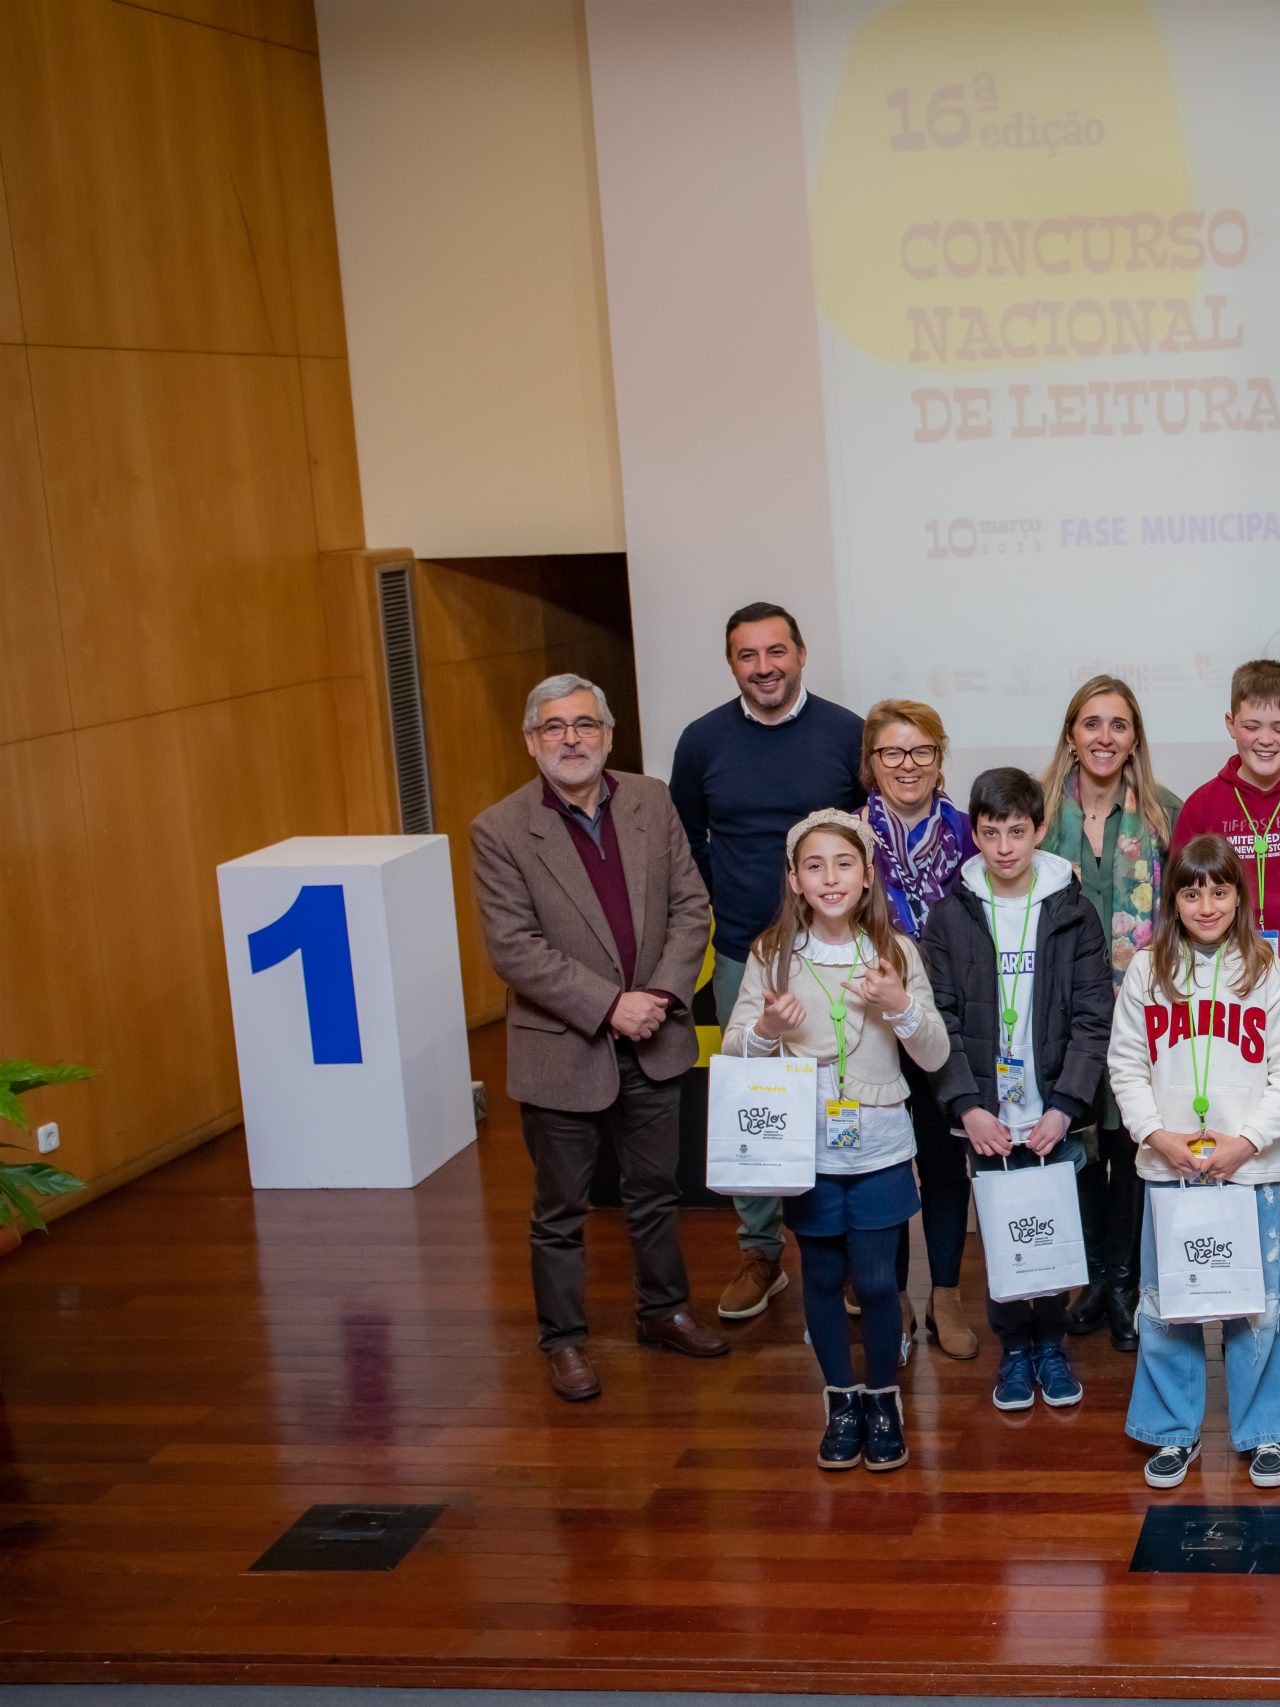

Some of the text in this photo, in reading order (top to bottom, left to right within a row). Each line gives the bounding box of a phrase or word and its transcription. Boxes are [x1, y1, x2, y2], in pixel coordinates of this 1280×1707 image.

[980, 112, 1105, 157] edição
[899, 207, 1250, 281] CONCURSO
[907, 294, 1243, 364] NACIONAL
[911, 387, 993, 443] DE
[924, 517, 977, 561] 10
[979, 514, 1041, 537] março
[1060, 516, 1127, 548] FASE
[1227, 834, 1263, 845] IMITED
[1234, 845, 1255, 854] NEW
[247, 884, 363, 1065] 1
[1144, 1000, 1267, 1065] PARIS
